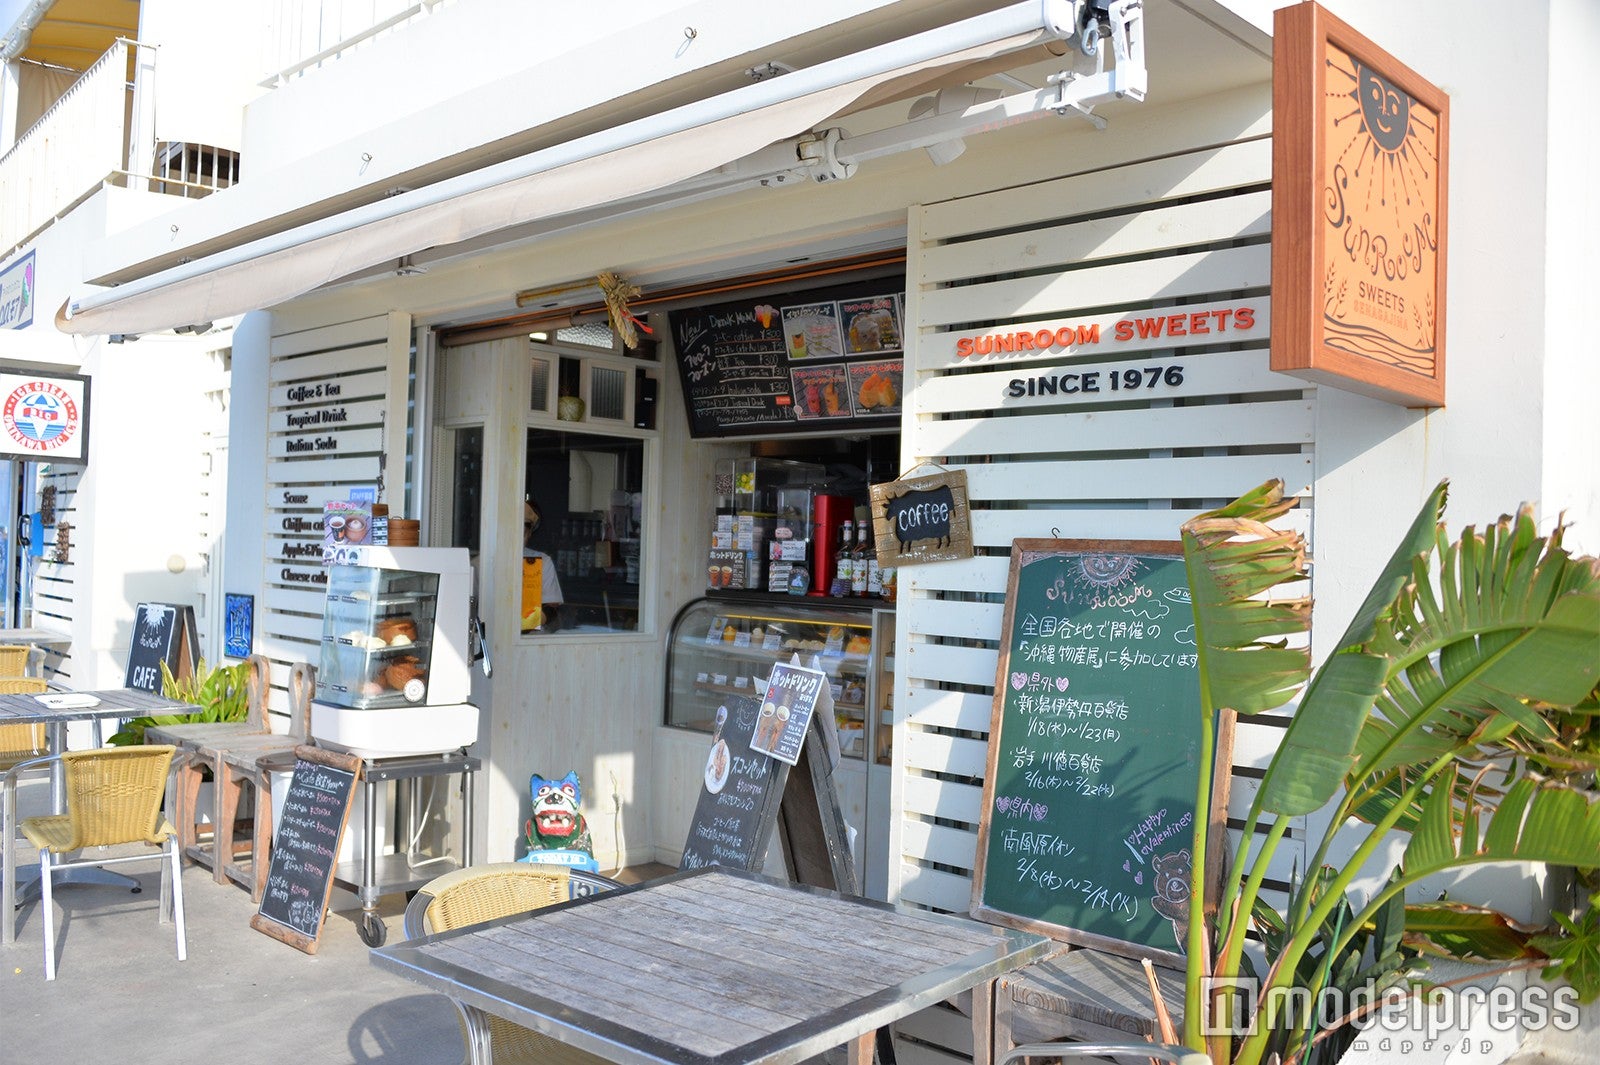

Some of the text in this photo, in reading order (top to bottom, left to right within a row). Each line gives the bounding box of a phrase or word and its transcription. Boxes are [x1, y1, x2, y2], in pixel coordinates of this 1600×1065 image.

[1359, 281, 1405, 313] SWEETS
[957, 307, 1256, 357] SUNROOM SWEETS
[287, 383, 340, 401] Coffee & Tea
[1008, 365, 1184, 398] SINCE 1976
[286, 408, 347, 428] Tropical Drink
[286, 436, 337, 452] Italian Soda
[281, 568, 310, 583] Cheese
[1021, 613, 1161, 641] 全国各地で開催の
[132, 665, 157, 689] CAFE
[772, 670, 817, 694] ホットドリンク
[1027, 672, 1055, 692] 県外
[1009, 796, 1033, 820] 県内
[1145, 817, 1189, 852] Valentine
